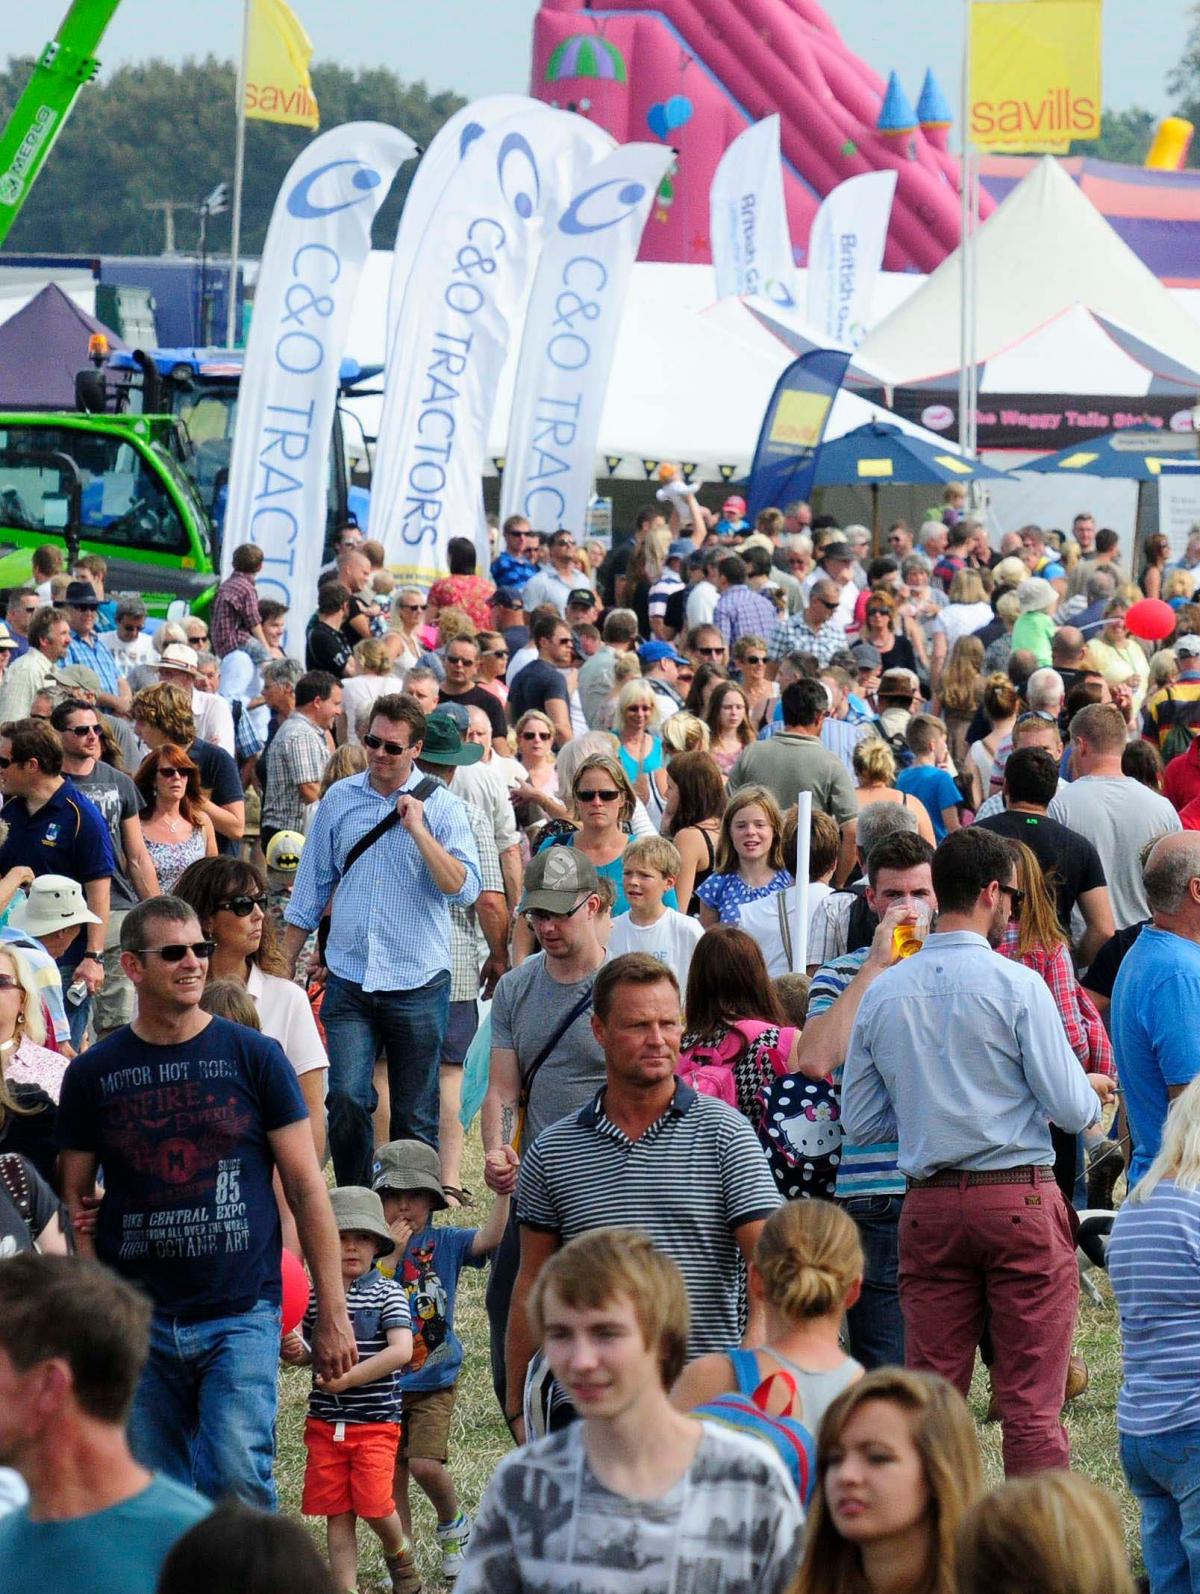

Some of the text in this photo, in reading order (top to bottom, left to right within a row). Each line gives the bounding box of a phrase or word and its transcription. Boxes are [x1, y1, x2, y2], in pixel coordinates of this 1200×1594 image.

[971, 88, 1097, 133] savills
[11, 104, 52, 174] MERLO
[275, 242, 341, 375] C&O
[547, 256, 608, 371] C&O
[402, 217, 506, 546] C&O TRACTORS
[100, 1065, 152, 1096] MOTOR
[159, 1062, 190, 1083] HOT
[215, 1170, 241, 1205] 85
[122, 1202, 247, 1229] BIKE CENTRAL EXPO
[168, 1226, 183, 1238] ALL
[184, 1224, 206, 1237] OVER
[208, 1222, 223, 1234] THE
[224, 1218, 249, 1232] WORLD
[225, 1229, 250, 1252] ART
